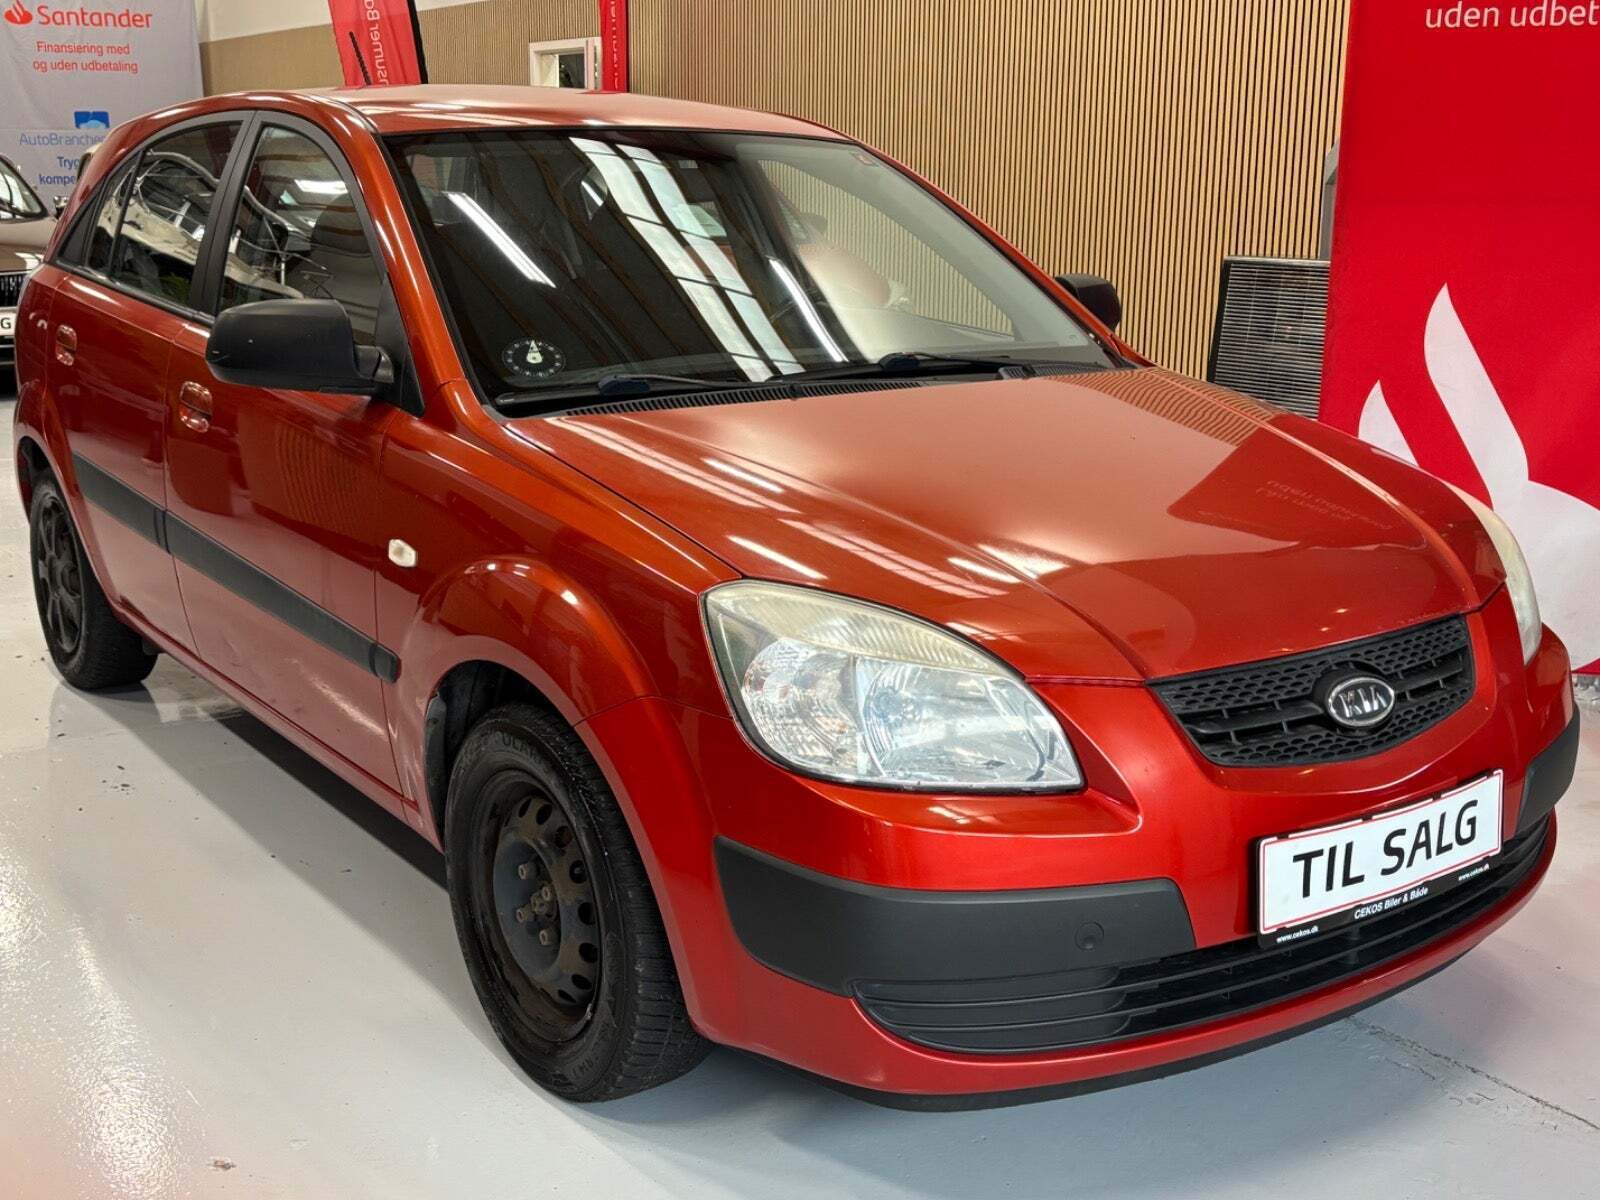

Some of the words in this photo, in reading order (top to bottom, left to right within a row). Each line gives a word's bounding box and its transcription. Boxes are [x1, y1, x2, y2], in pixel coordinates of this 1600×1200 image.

[37, 5, 152, 28] Santander
[1425, 0, 1499, 28] uden
[1510, 0, 1600, 27] udbet
[36, 41, 103, 56] Finansiering
[106, 44, 130, 55] med
[33, 61, 48, 73] og
[51, 60, 77, 70] uden
[81, 61, 138, 74] udbetaling
[1338, 684, 1388, 718] KIA
[1293, 841, 1365, 898] TIL
[1380, 799, 1479, 876] SALG
[1354, 902, 1383, 919] CEKOS
[1384, 896, 1402, 910] Biler
